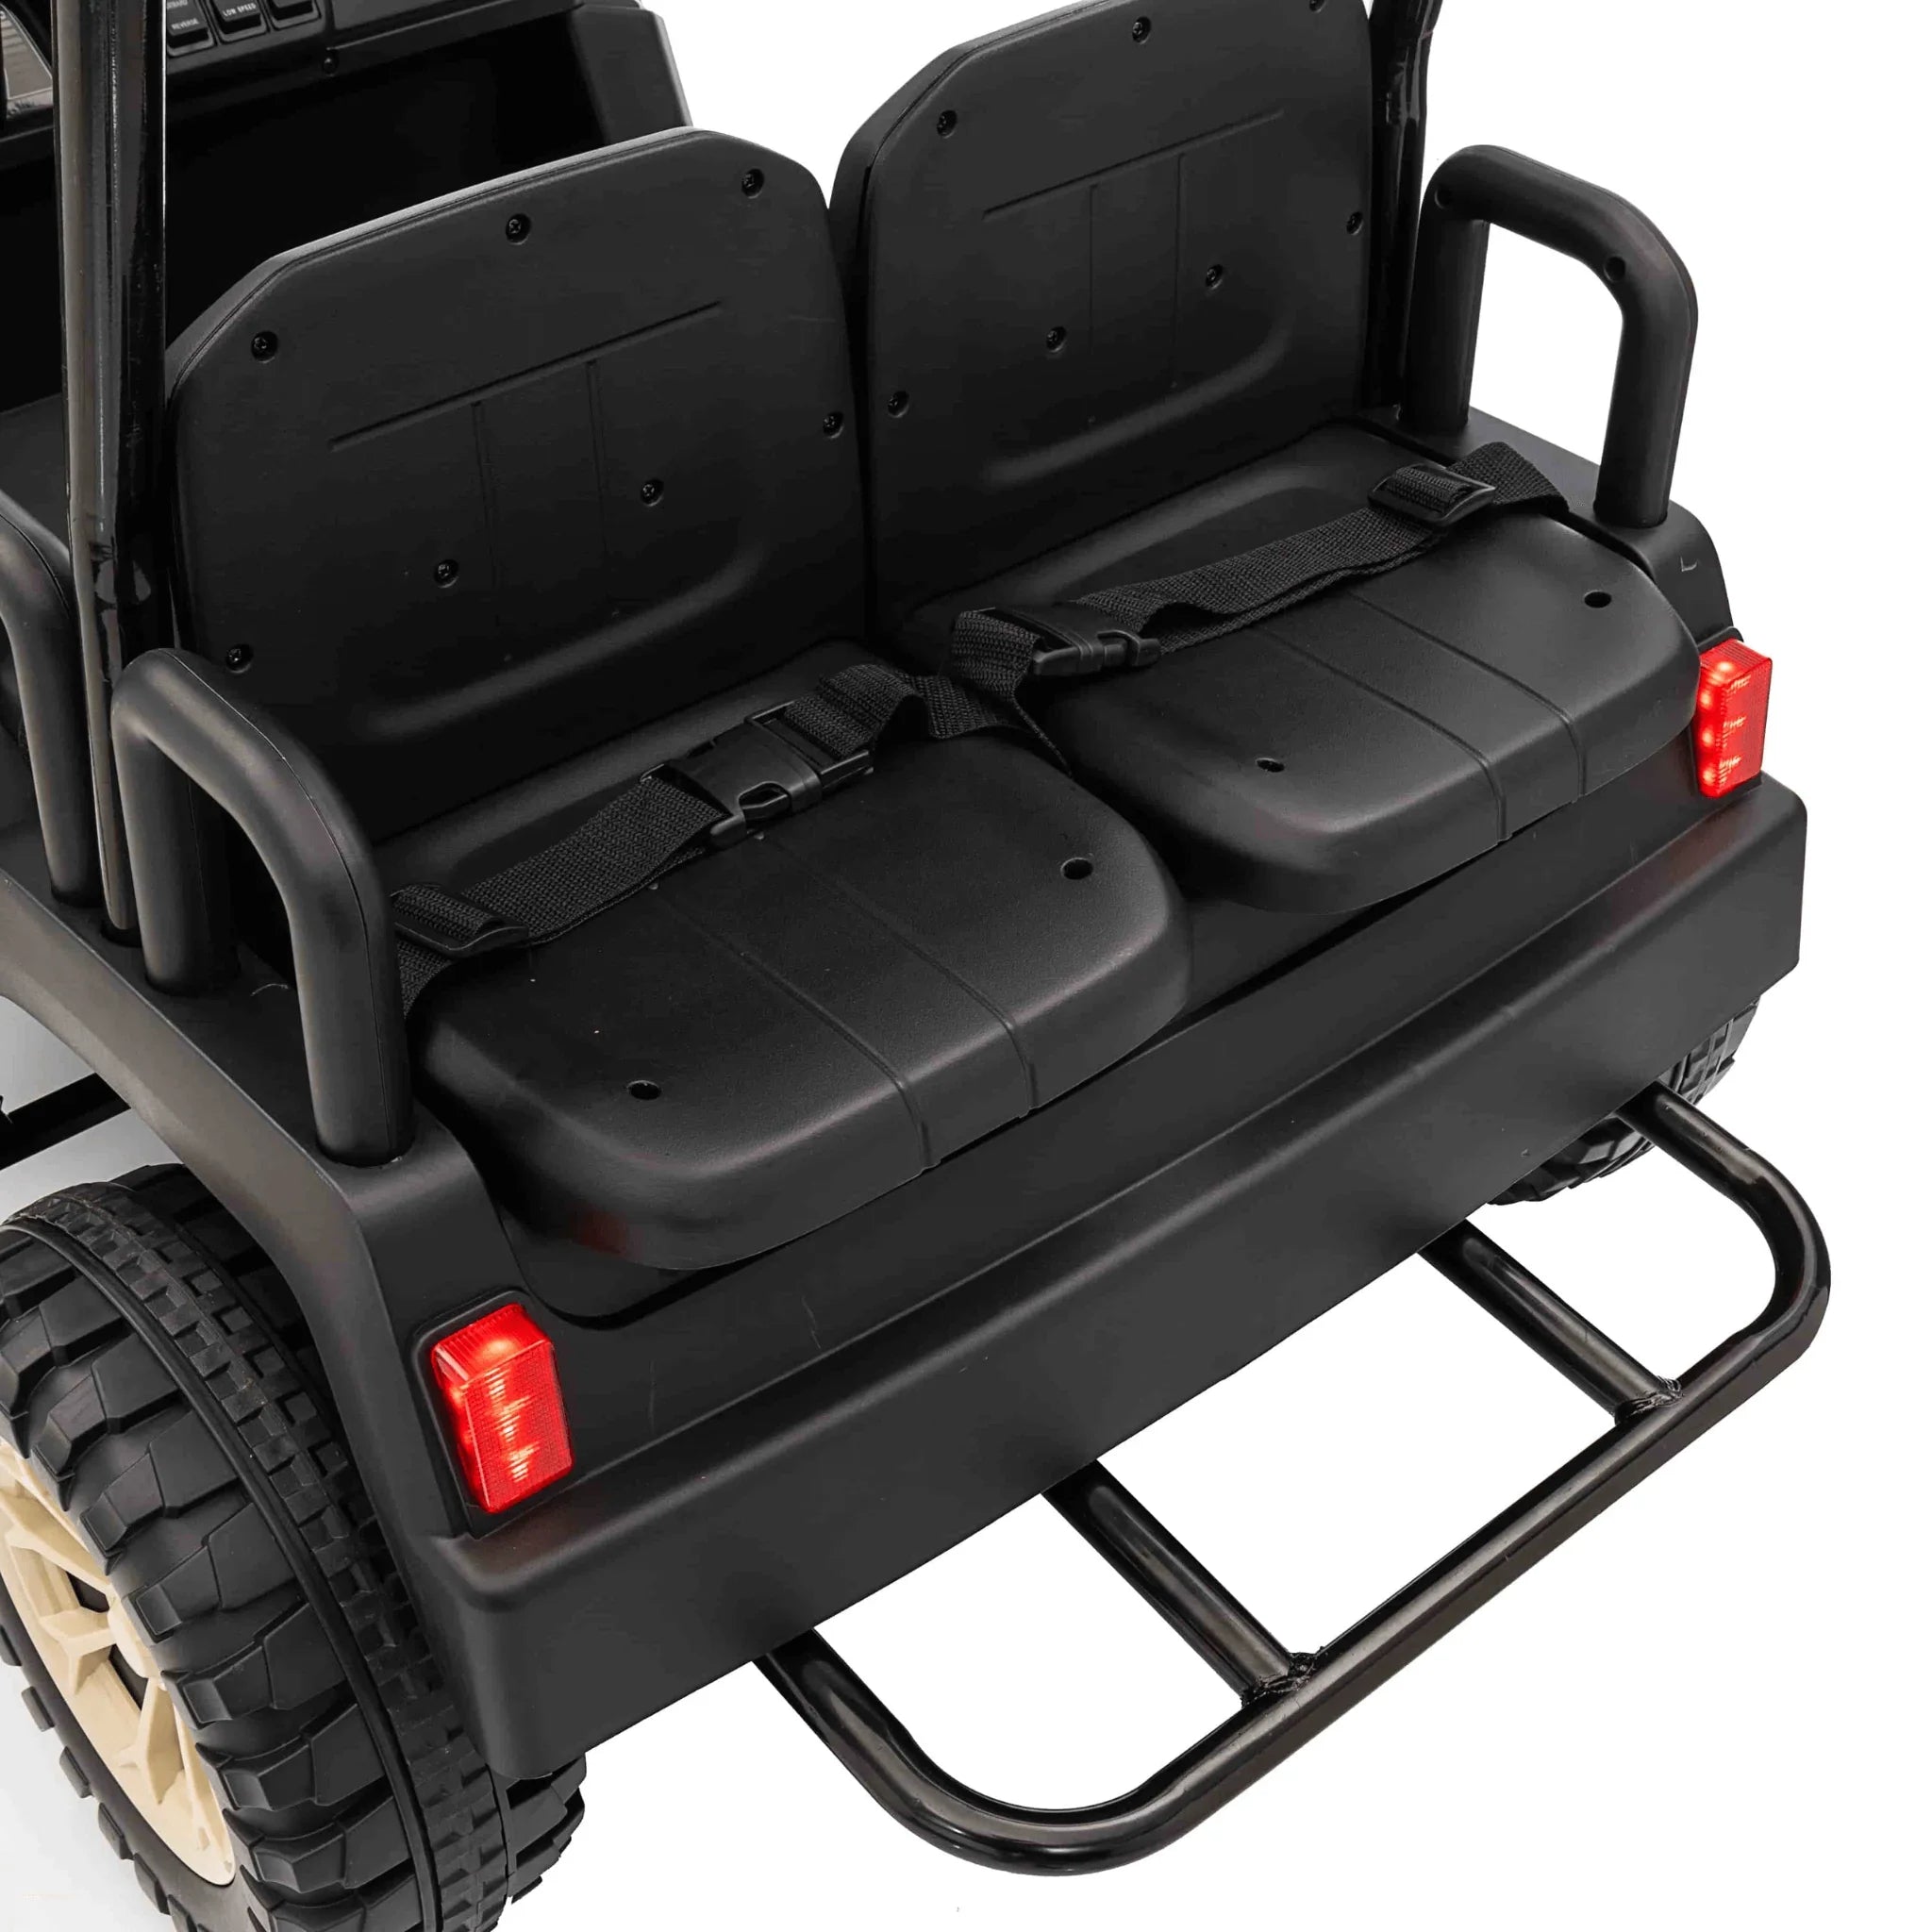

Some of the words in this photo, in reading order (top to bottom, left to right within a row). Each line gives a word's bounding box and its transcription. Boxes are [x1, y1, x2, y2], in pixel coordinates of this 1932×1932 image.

[222, 8, 237, 17] LOW
[237, 2, 257, 13] SPEED
[171, 18, 200, 30] REVERSE
